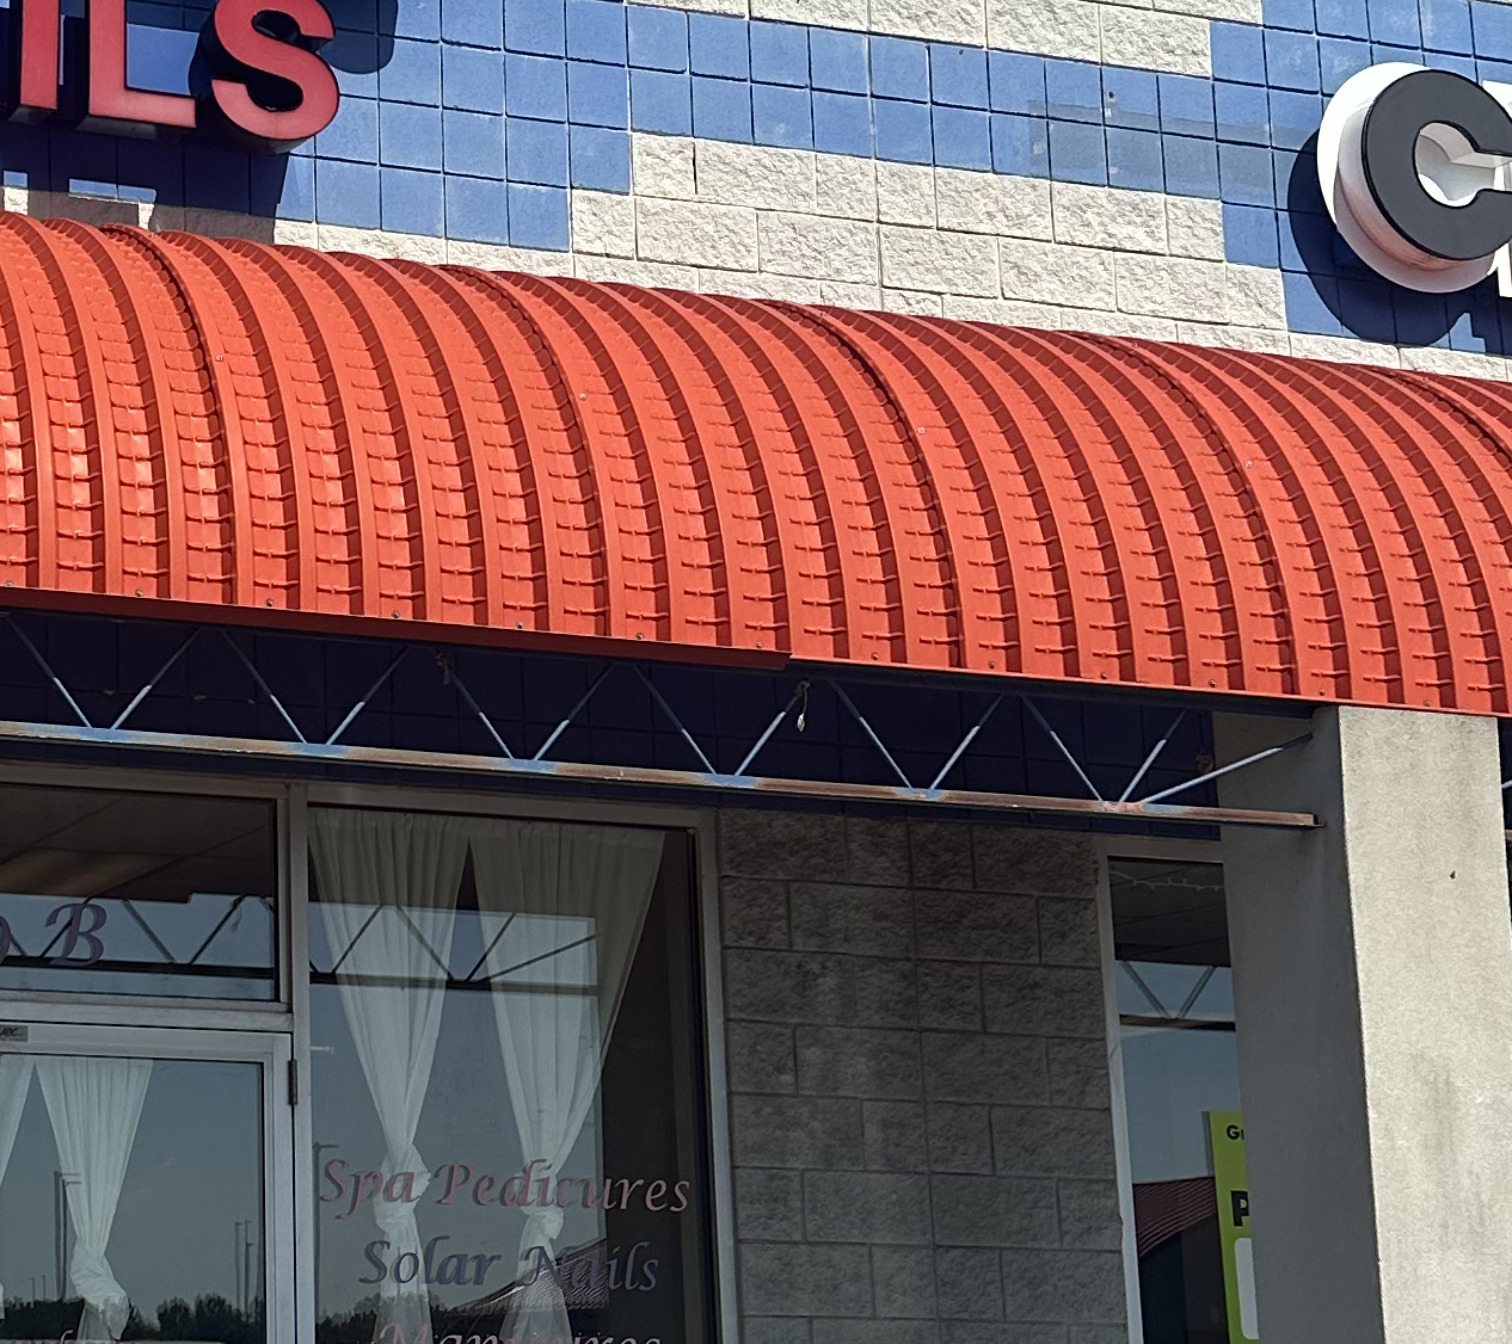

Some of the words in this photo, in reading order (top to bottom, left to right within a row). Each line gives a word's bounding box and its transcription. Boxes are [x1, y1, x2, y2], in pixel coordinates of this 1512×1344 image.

[45, 902, 107, 967] B
[319, 1157, 422, 1220] Spa
[434, 1159, 690, 1213] Pedicures
[358, 1234, 502, 1286] Solar
[517, 1241, 660, 1292] Nails
